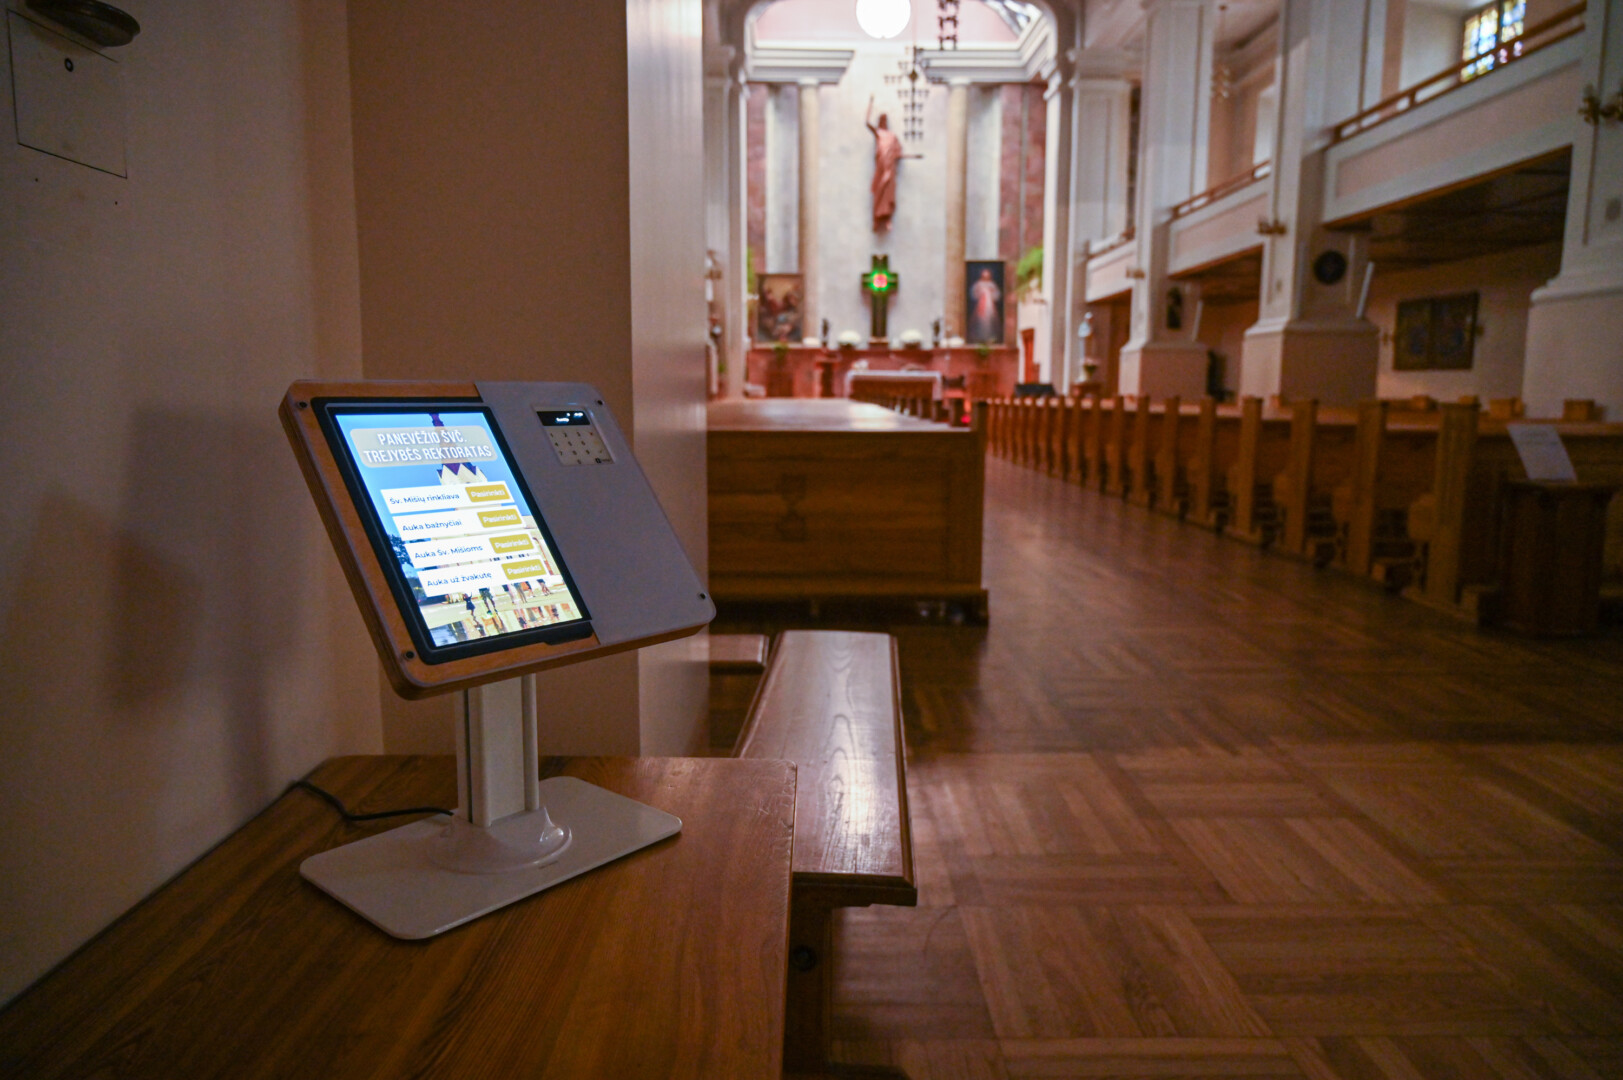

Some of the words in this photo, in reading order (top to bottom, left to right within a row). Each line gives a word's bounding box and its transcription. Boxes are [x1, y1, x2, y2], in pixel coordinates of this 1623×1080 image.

[377, 431, 439, 446] PANEVĖŽIO
[441, 429, 467, 443] ŠVČ.
[363, 447, 422, 463] TREJYBĖS
[423, 445, 492, 460] REKTORATAS
[426, 493, 460, 501] rinkliava
[471, 490, 505, 498] Pasirinkti
[402, 523, 424, 531] Auka
[415, 551, 436, 559] Auka
[427, 577, 449, 587] Auka
